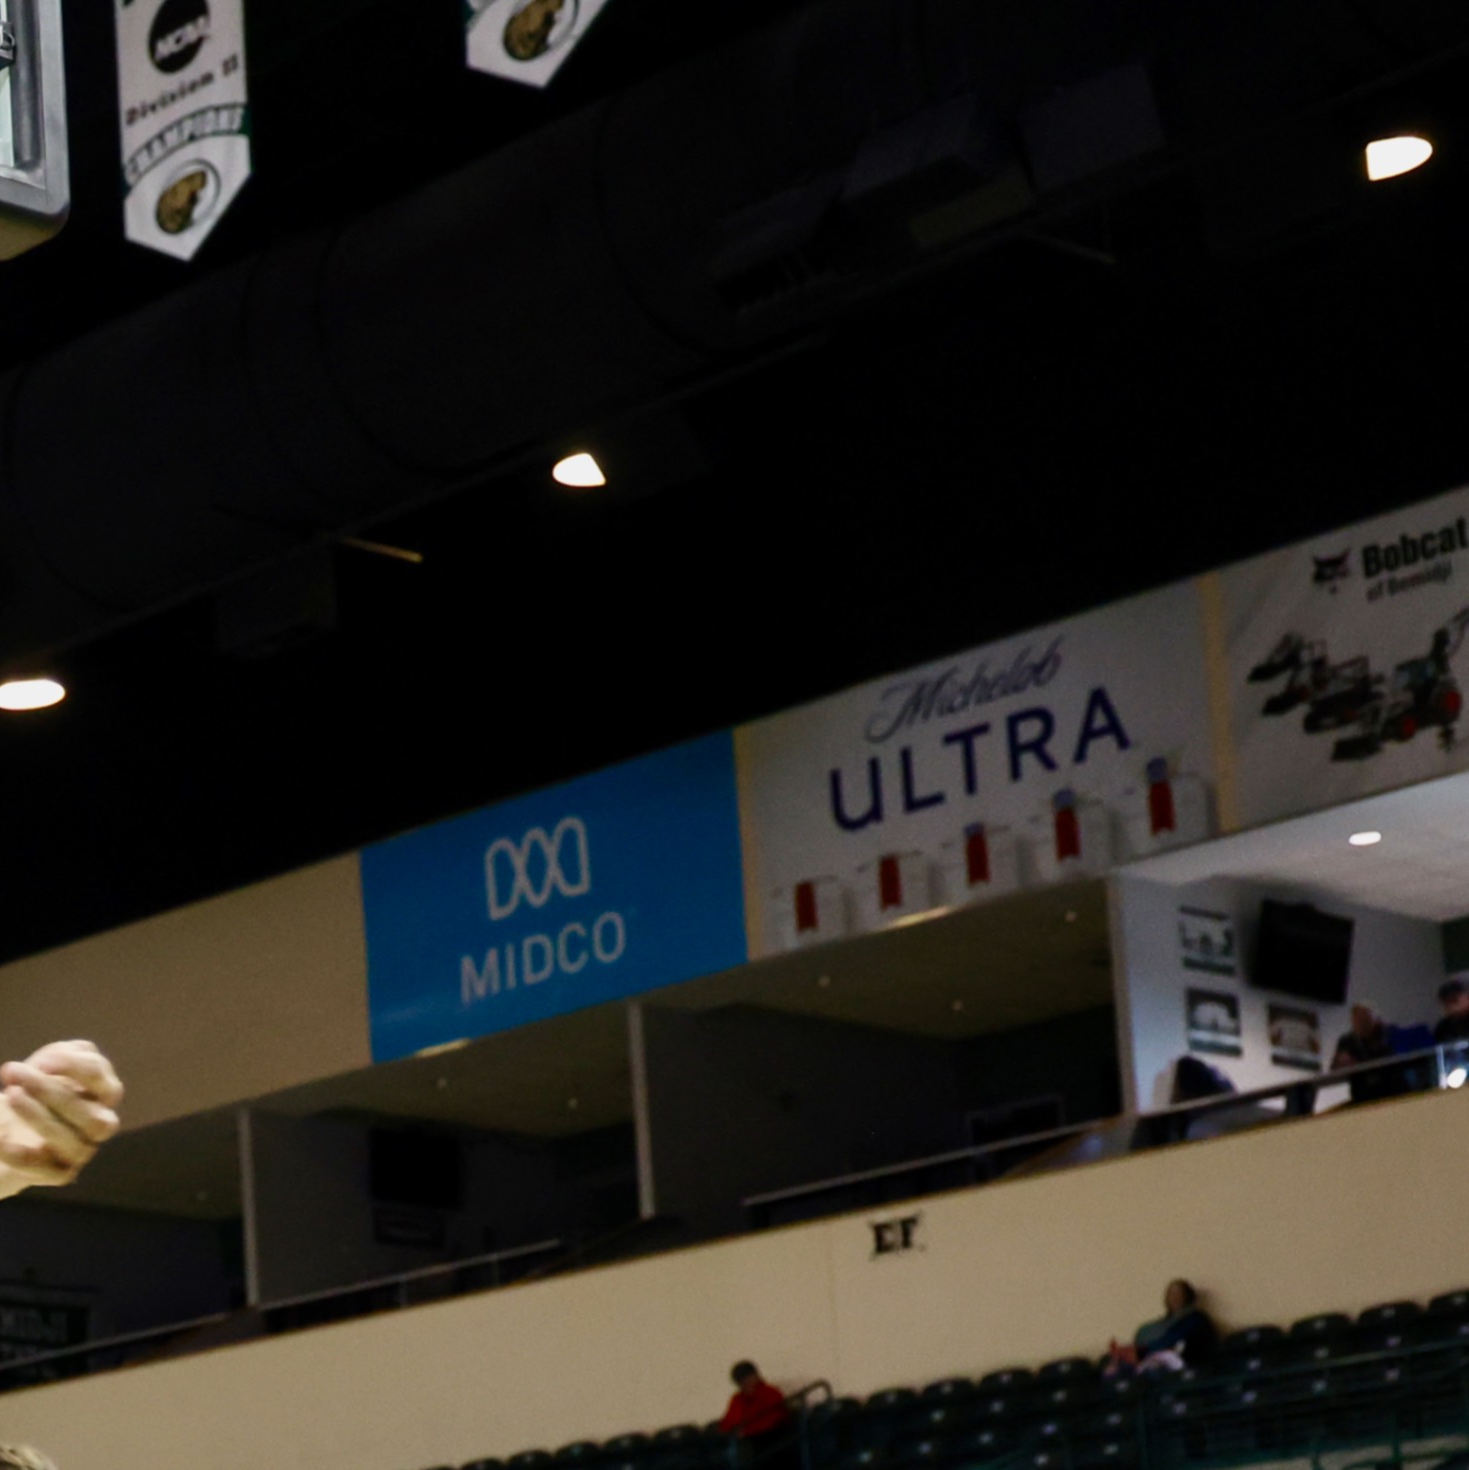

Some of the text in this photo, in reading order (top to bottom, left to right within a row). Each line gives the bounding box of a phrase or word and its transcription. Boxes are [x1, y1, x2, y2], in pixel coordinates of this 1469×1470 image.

[1363, 516, 1468, 578] Bobcat
[830, 686, 1131, 831] ULTRA
[461, 911, 628, 1009] MIDCO
